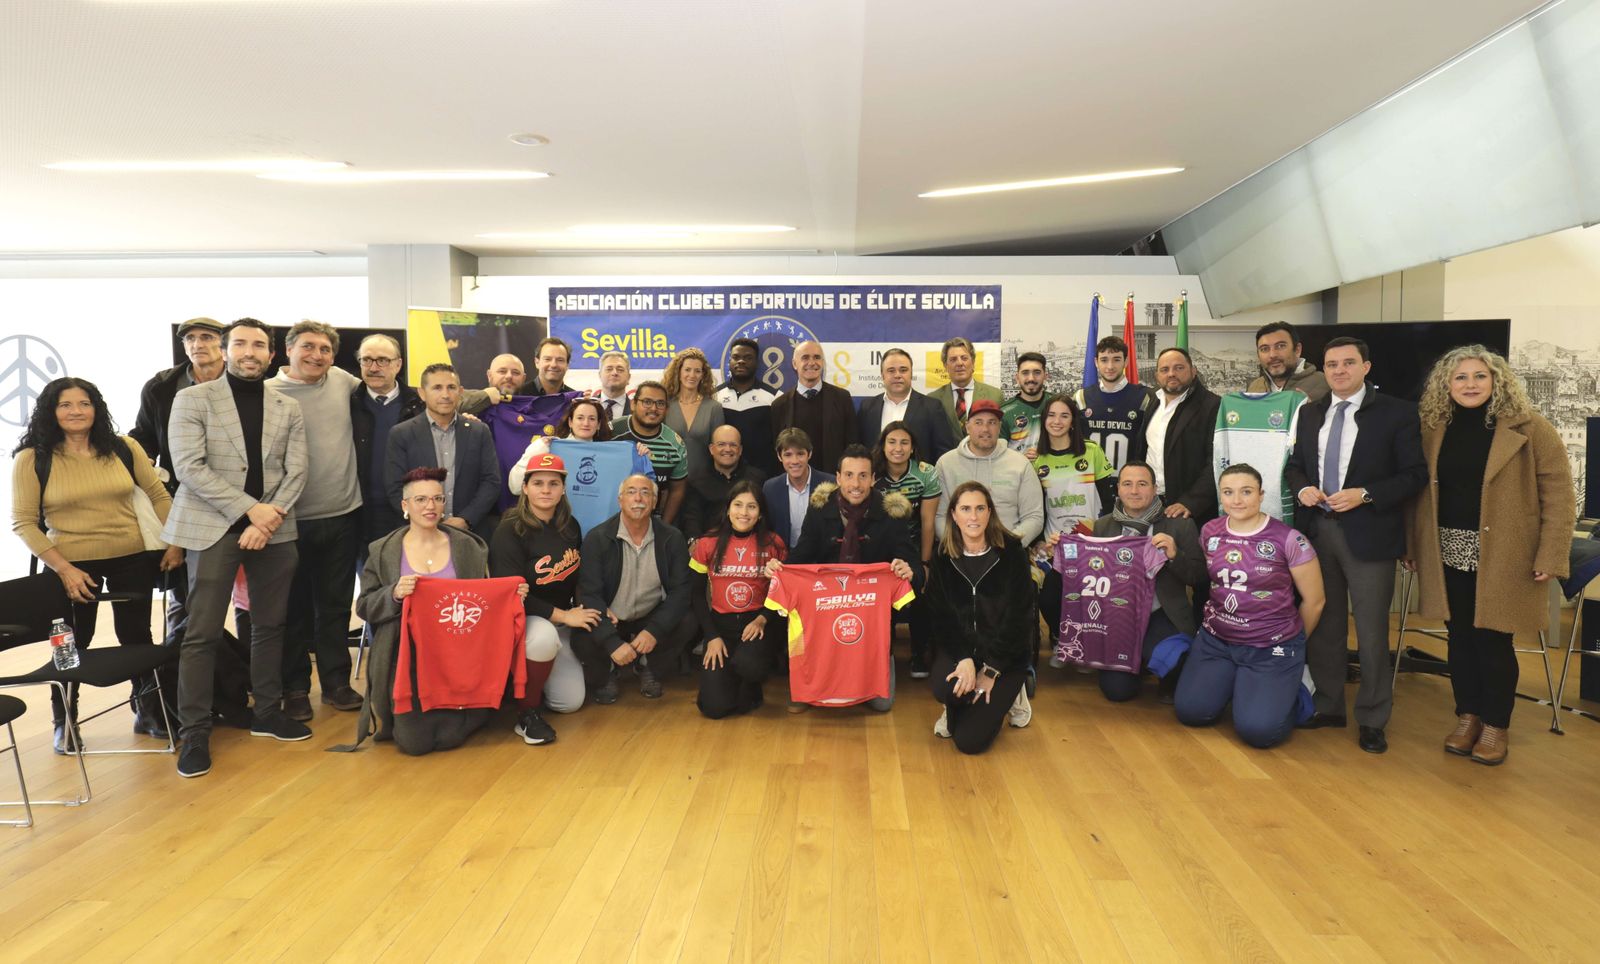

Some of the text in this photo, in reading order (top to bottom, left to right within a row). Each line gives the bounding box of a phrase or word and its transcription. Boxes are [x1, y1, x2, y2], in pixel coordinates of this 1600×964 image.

[555, 289, 995, 311] ASOCIACIÓN CLUBES DEPORTIVOS DE ÉLITE SEVILLA
[581, 328, 676, 352] Sevilla.
[1088, 420, 1133, 430] BLUE DEVILS
[540, 455, 555, 466] S
[534, 548, 581, 585] Sevilla
[1081, 575, 1111, 598] 20
[1216, 568, 1248, 592] 12
[816, 593, 876, 606] ISBILYA
[446, 627, 472, 635] CLUB
